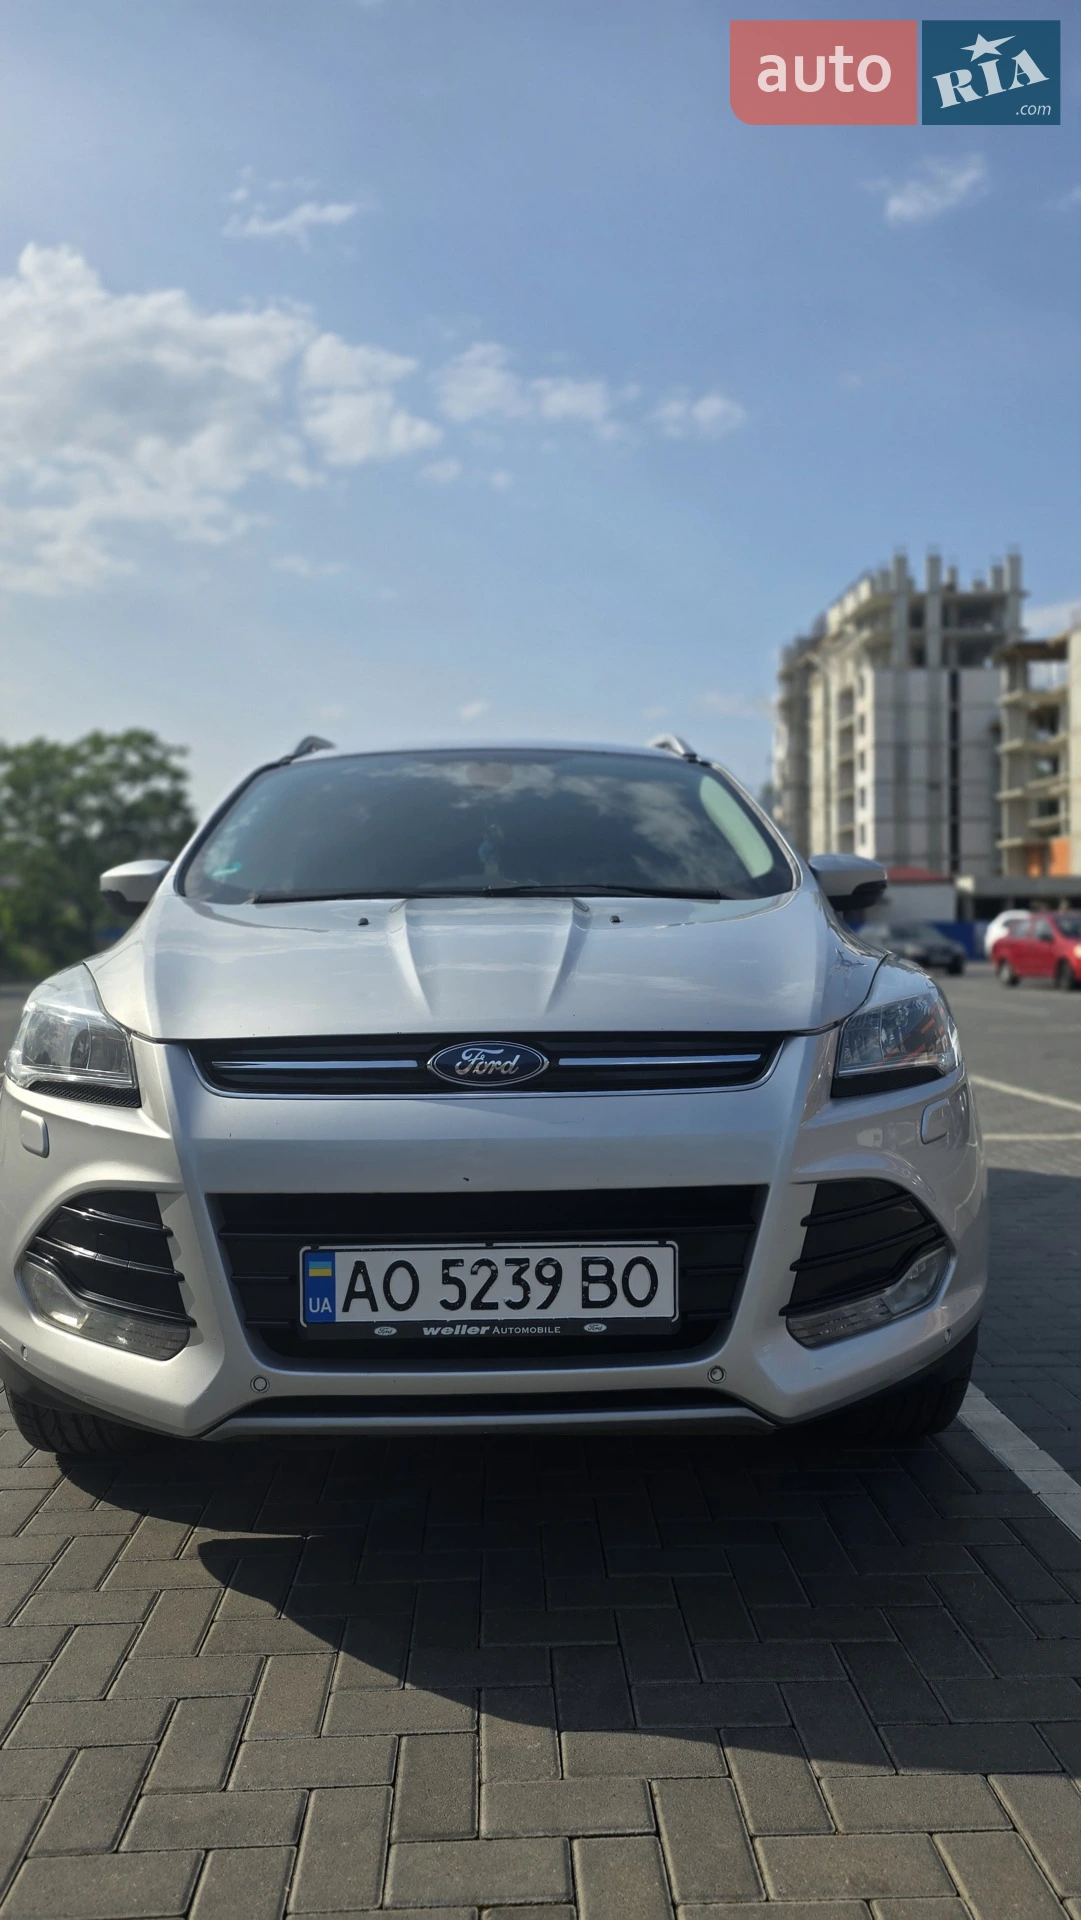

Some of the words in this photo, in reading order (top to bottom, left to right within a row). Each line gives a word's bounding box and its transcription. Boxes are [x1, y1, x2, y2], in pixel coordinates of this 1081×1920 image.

[454, 1047, 521, 1075] Ford
[341, 1260, 420, 1312] AO
[439, 1256, 563, 1311] 5239
[581, 1256, 659, 1309] BO
[309, 1297, 333, 1313] UA
[422, 1324, 491, 1336] weller
